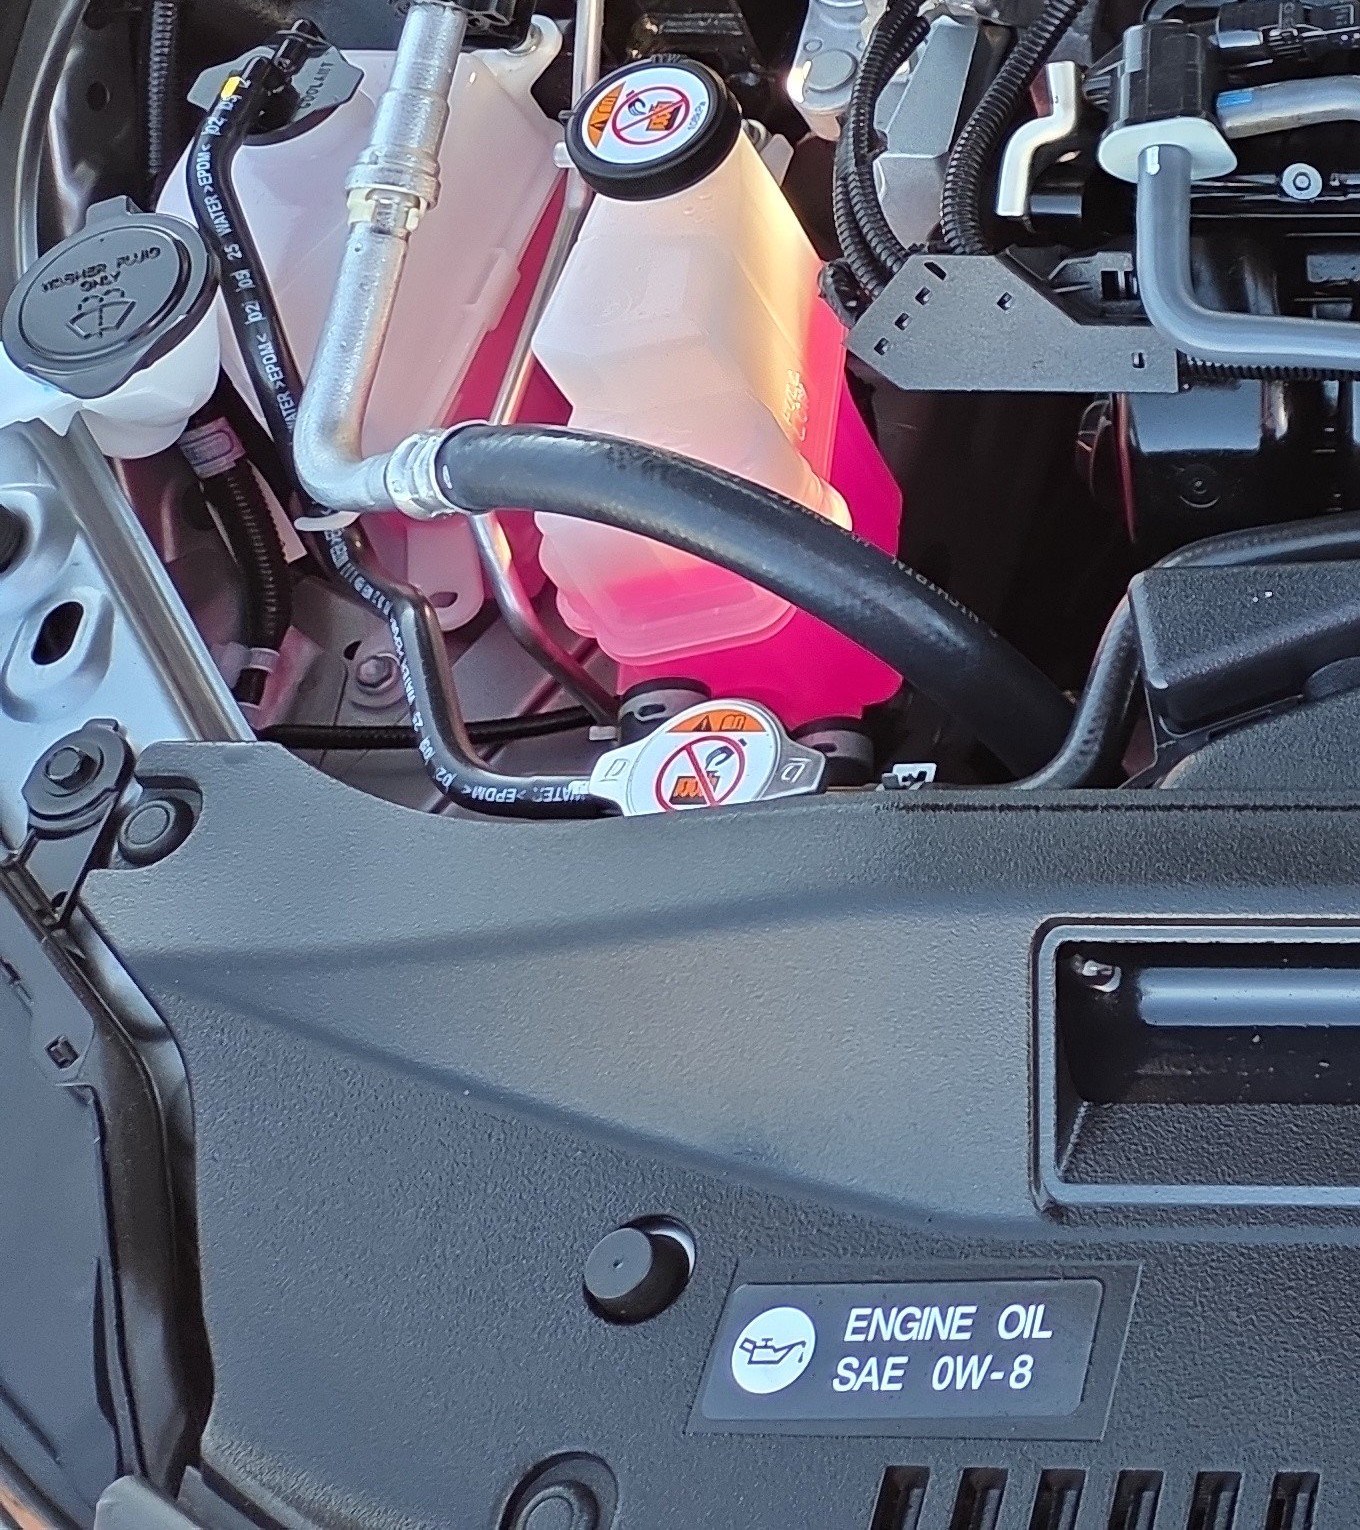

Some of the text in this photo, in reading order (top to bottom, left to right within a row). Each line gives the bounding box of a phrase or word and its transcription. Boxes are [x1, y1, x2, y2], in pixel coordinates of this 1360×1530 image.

[299, 61, 334, 110] COOLANT
[204, 193, 232, 237] WATER
[41, 246, 161, 293] WASHER FLUID
[224, 243, 243, 261] 25
[80, 270, 121, 291] ONLY
[843, 1304, 1054, 1342] ENGINE OIL
[832, 1353, 1033, 1392] SAE 0W-8
